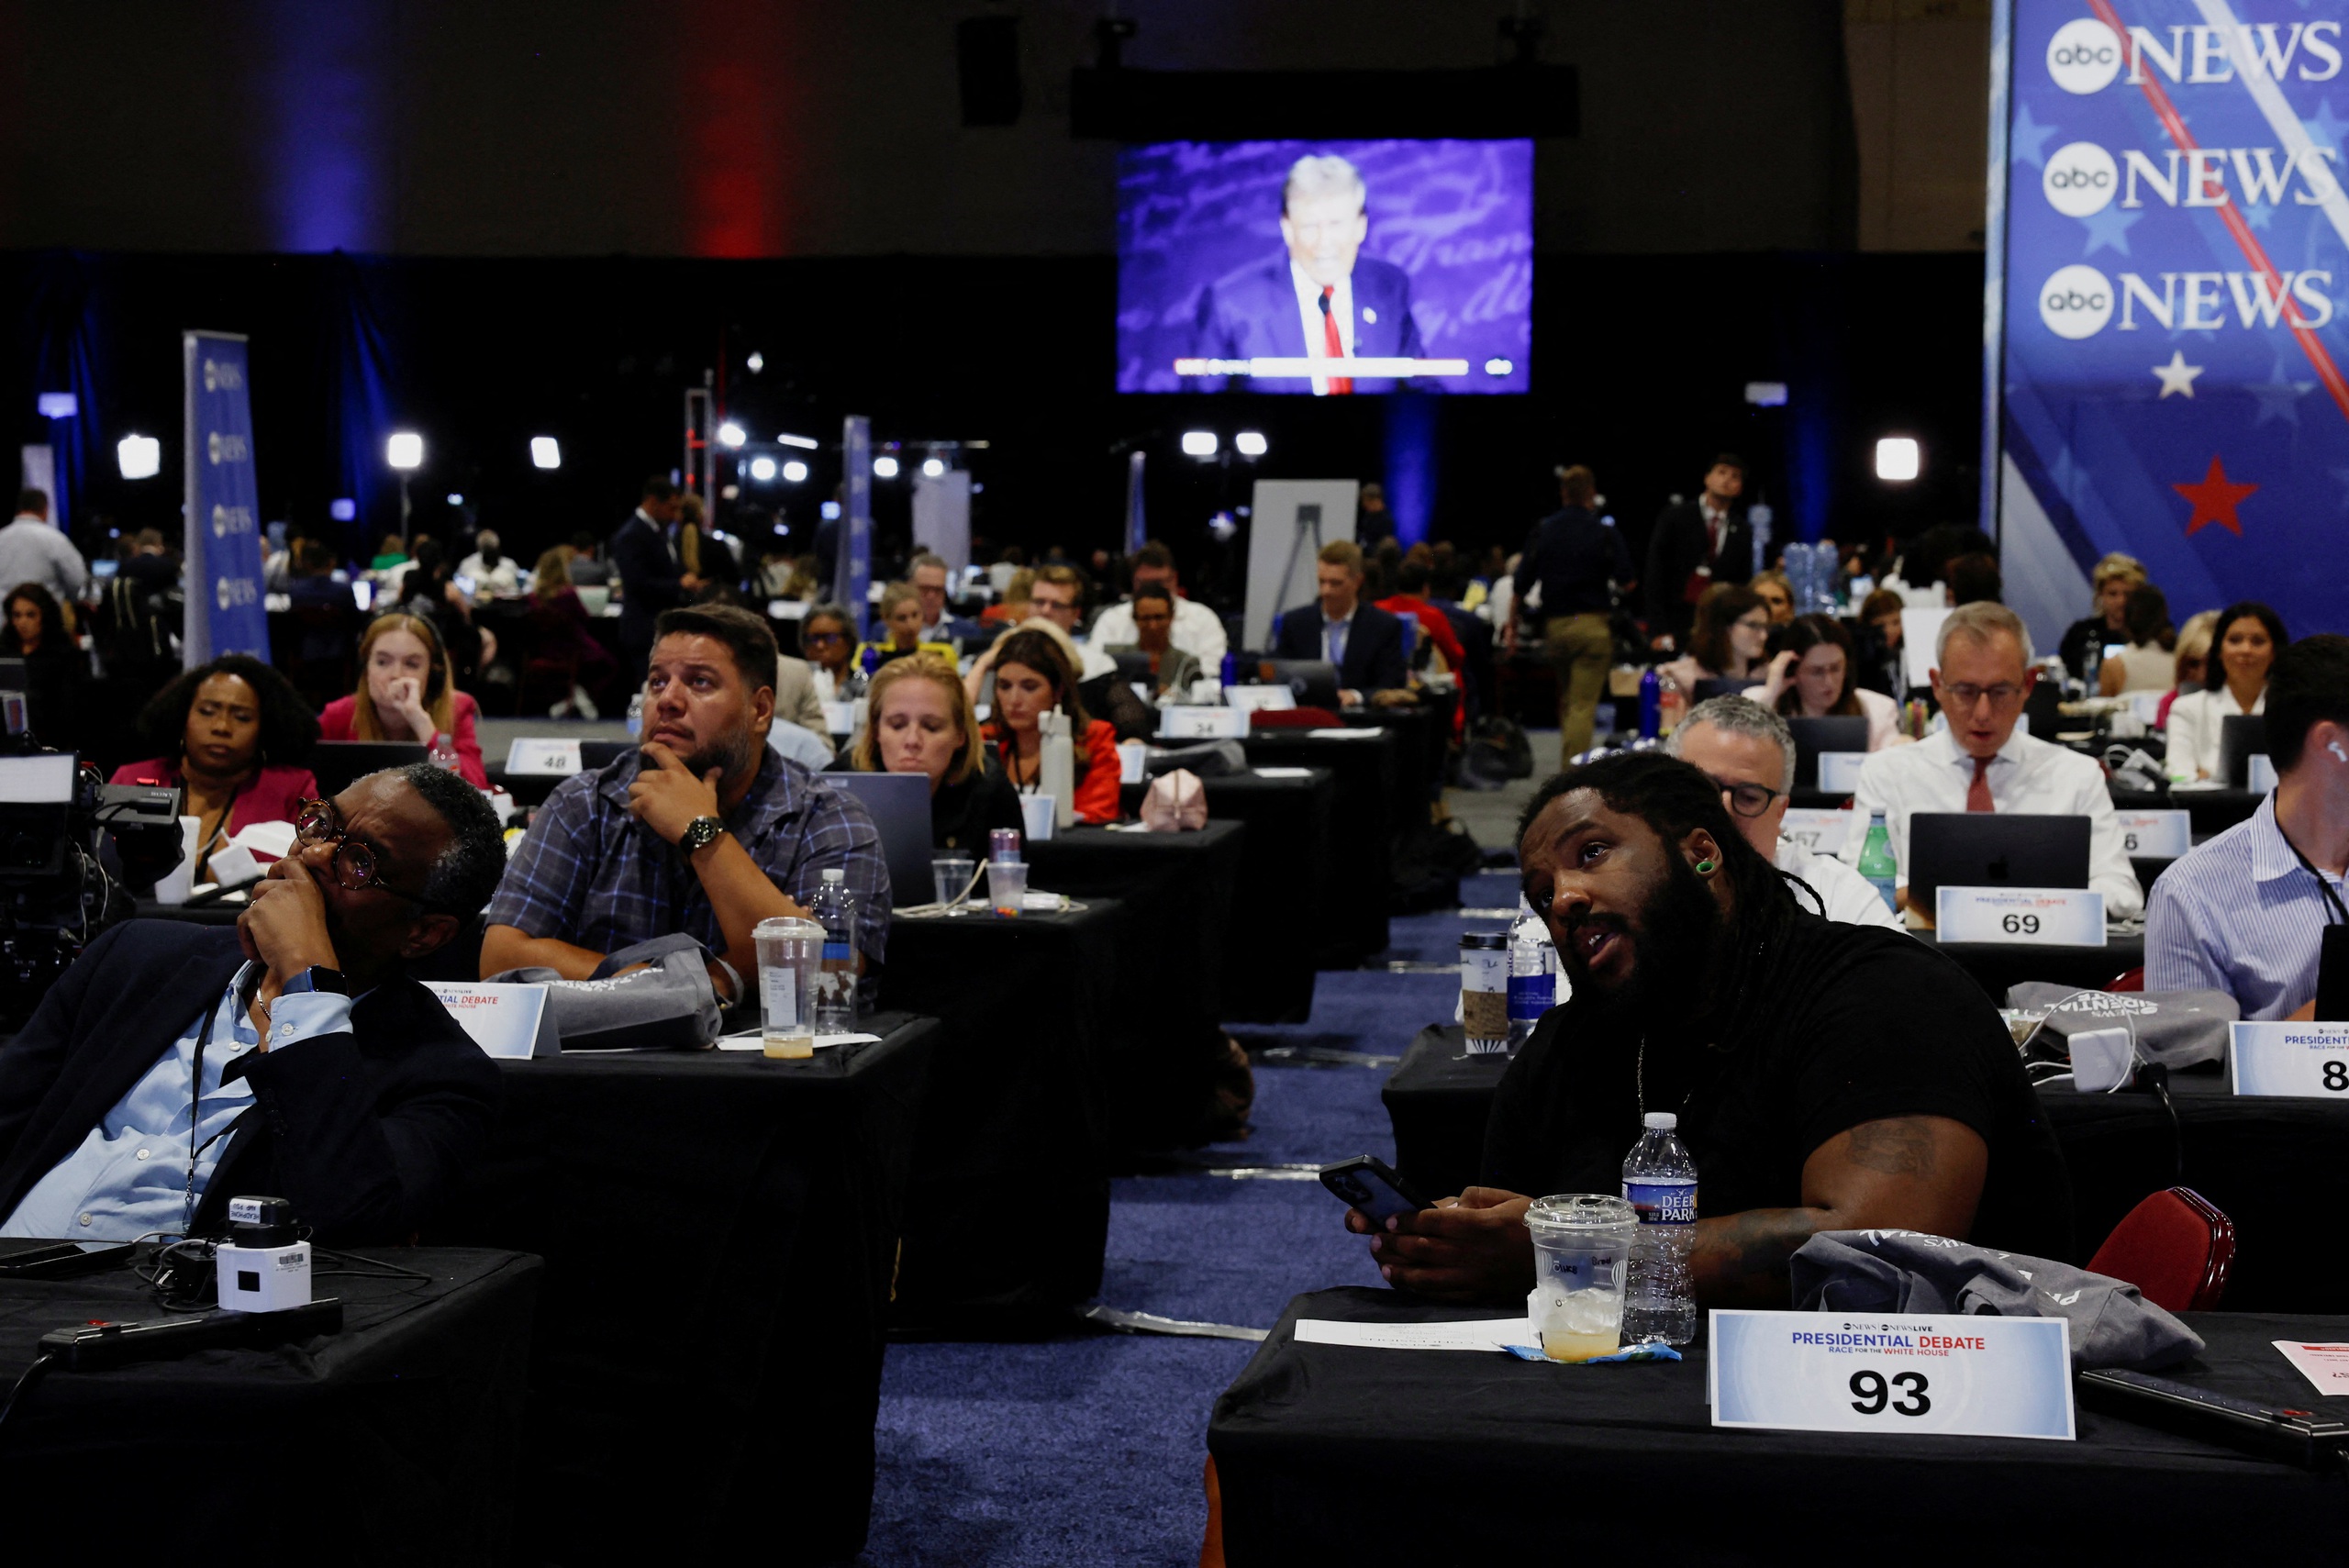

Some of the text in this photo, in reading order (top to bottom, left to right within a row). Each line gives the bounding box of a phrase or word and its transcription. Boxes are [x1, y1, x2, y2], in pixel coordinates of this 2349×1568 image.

[2054, 20, 2343, 85] abc NEWS
[2051, 146, 2338, 209] abc NEWS
[2046, 270, 2334, 331] abc NEWS
[2002, 914, 2040, 934] 69
[462, 996, 498, 1005] DEBATE
[2322, 1061, 2349, 1092] 8
[1662, 1195, 1695, 1208] DEER
[1662, 1207, 1695, 1221] PARK
[1792, 1332, 1986, 1350] PRESIDENTIAL DEBATE
[1884, 1348, 1914, 1356] WHITE
[1917, 1349, 1949, 1357] HOUSE
[1848, 1369, 1932, 1417] 93
